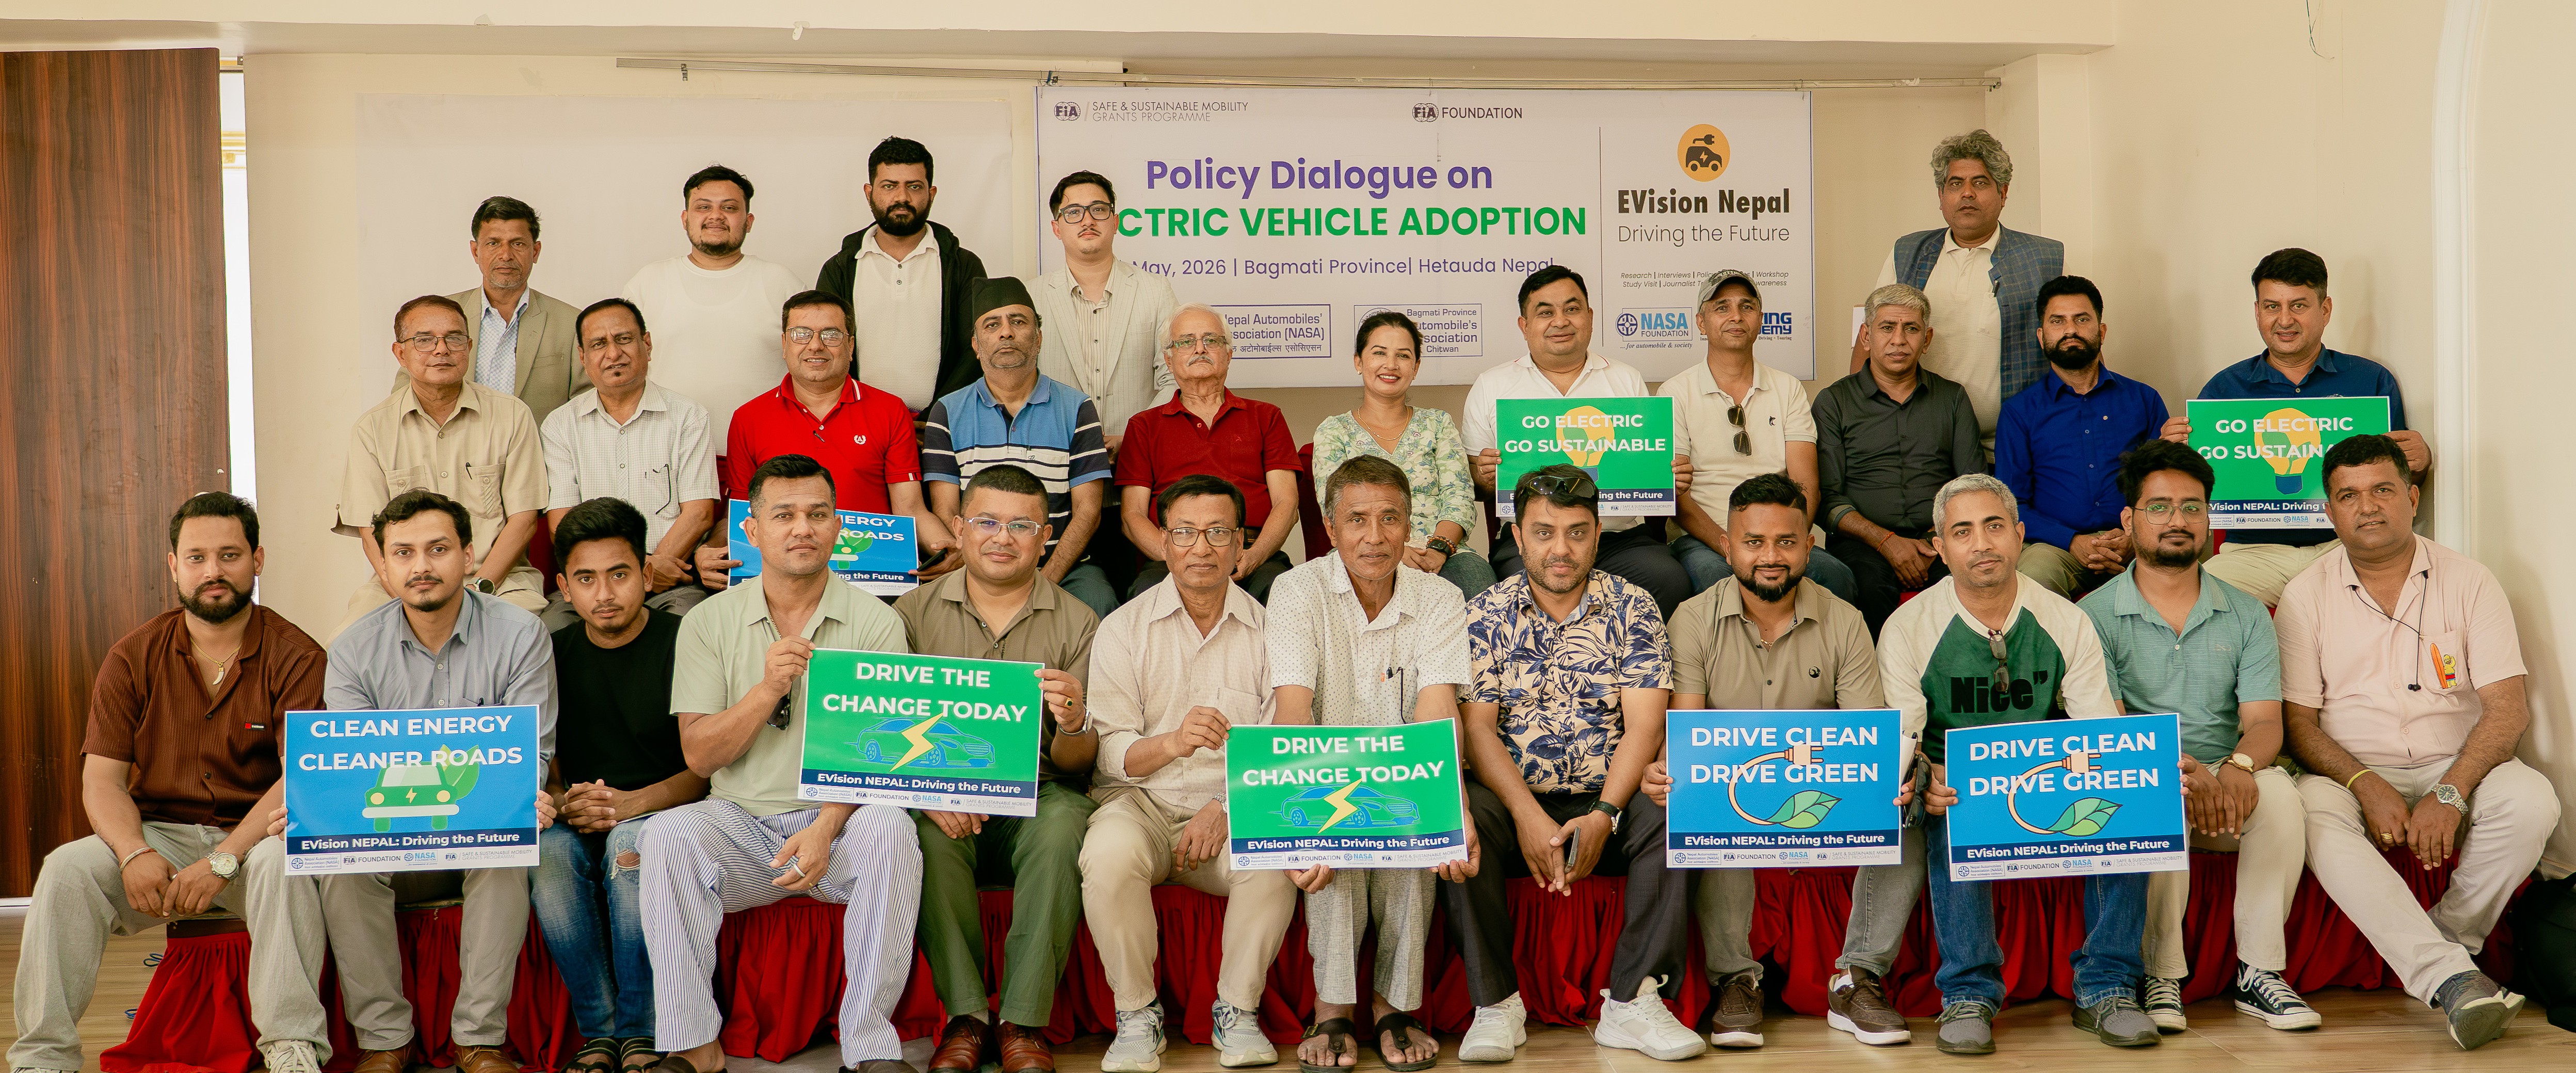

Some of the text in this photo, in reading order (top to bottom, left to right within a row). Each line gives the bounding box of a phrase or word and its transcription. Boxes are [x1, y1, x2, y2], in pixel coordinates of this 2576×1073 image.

[1092, 102, 1248, 111] SAFE & SUSTAINABLE MOBILITY
[1442, 107, 1522, 119] FOUNDATION
[1092, 112, 1211, 122] GRANTS PROGRAMME
[1147, 157, 1492, 200] Policy Dialogue on
[1618, 188, 1790, 220] EVision Nepal
[1118, 207, 1586, 237] CTRIC VEHICLE ADOPTION
[1619, 225, 1789, 247] Driving the Future
[1182, 260, 1226, 275] 2026
[1245, 259, 1323, 279] Bagmati
[1420, 258, 1496, 273] Hetauda
[1503, 258, 1553, 277] Nepal
[1226, 314, 1250, 327] epal
[1407, 309, 1440, 318] Bagmati
[1641, 313, 1688, 330] NASA
[1762, 312, 1792, 324] ING
[1419, 320, 1477, 330] tomobile's
[1759, 325, 1792, 335] EMY
[1231, 327, 1324, 341] sociation (NASA)
[1424, 332, 1477, 343] sociation
[1522, 414, 1643, 428] GO ELECTRIC
[2215, 417, 2354, 434] GO ELECTRIC
[1505, 439, 1666, 453] GO SUSTAINABLE
[2197, 444, 2333, 460] GO SUSTAIN
[2282, 503, 2320, 511] Driving
[841, 515, 896, 527] ERGY
[838, 530, 905, 541] ROADS
[857, 662, 990, 688] DRIVE THE
[823, 694, 1027, 723] CHANGE TODAY
[310, 715, 512, 738] CLEAN ENERGY
[1691, 726, 1878, 746] DRIVE CLEAN
[1273, 735, 1404, 755] DRIVE THE
[1970, 732, 2156, 761] DRIVE CLEAN
[298, 747, 523, 771] CLEANER ROADS
[1243, 760, 1444, 786] CHANGE TODAY
[1691, 763, 1878, 784] DRIVE GREEN
[817, 774, 1021, 795] EVision NEPAL: Driving the Future
[1969, 768, 2159, 796] DRIVE GREEN
[301, 832, 520, 851] EVision NEPAL: Driving the Future
[1248, 836, 1449, 850] EVision NEPAL: Driving the Future
[1685, 835, 1885, 846] EVision NEPAL: Driving the Future
[1967, 840, 2169, 858] EVision NEPAL: Driving the Future
